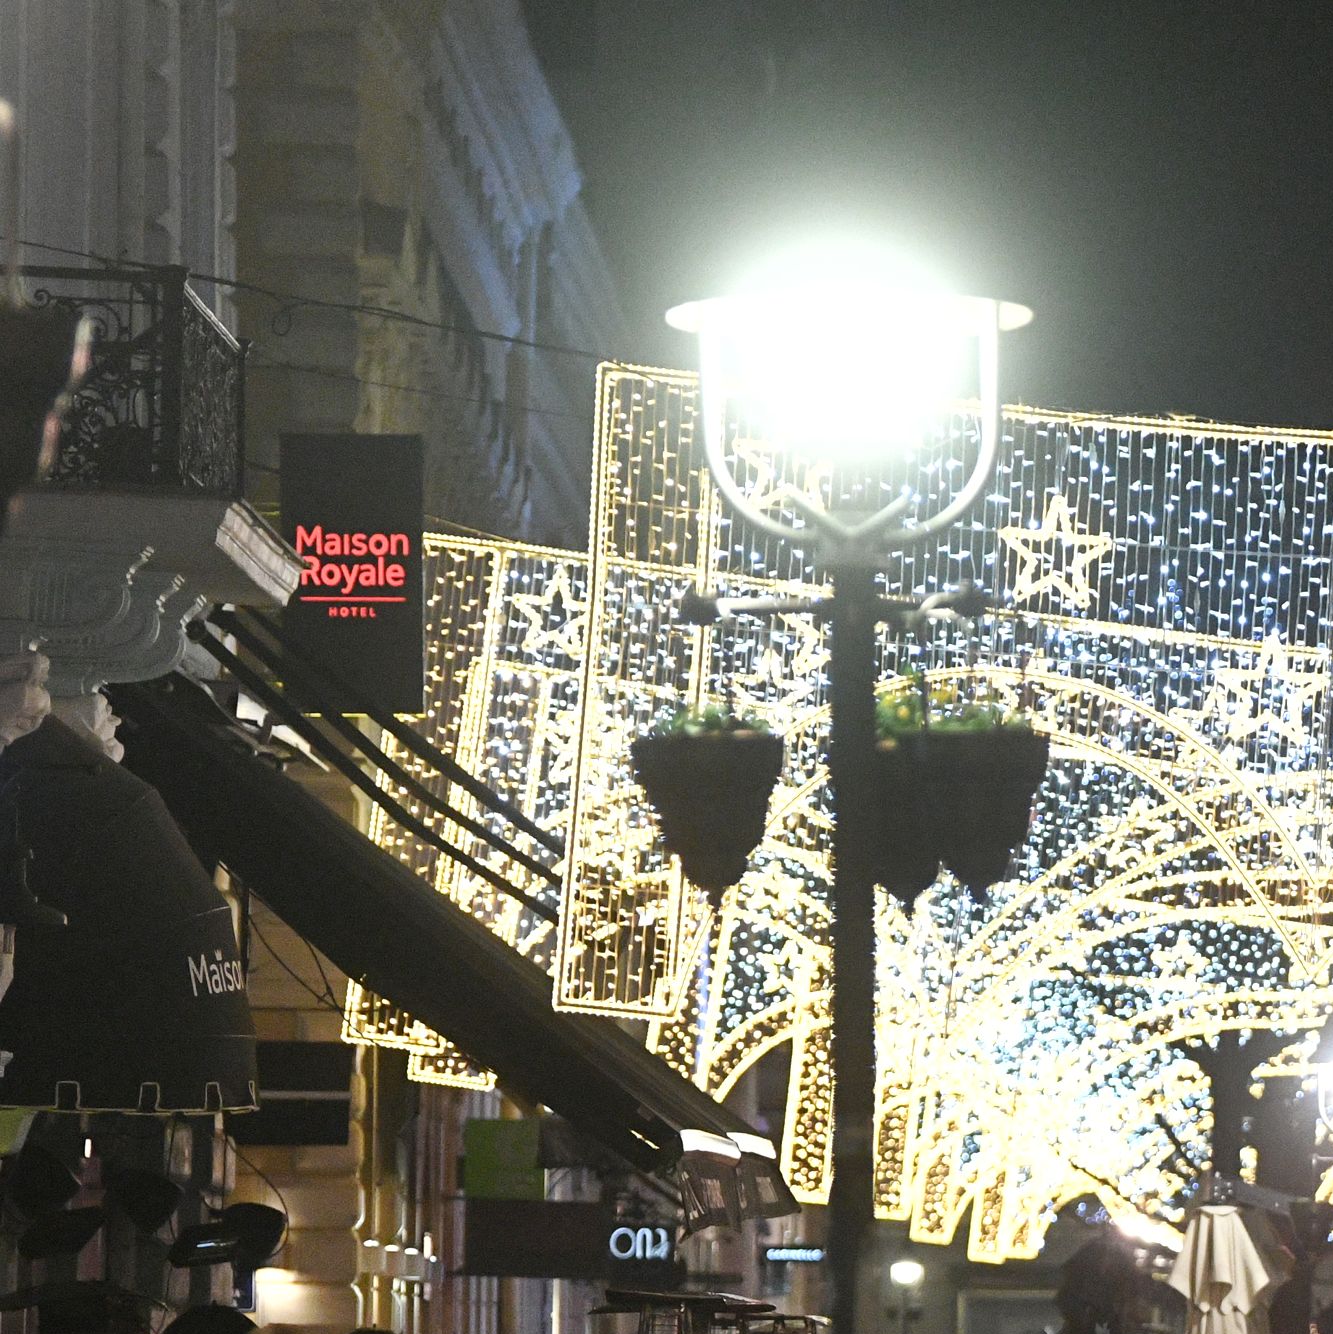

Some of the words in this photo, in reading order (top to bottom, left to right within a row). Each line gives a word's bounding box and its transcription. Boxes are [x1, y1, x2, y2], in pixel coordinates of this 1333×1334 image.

[296, 524, 410, 556] Maison
[300, 555, 406, 595] Royale
[328, 606, 377, 618] HOTEL
